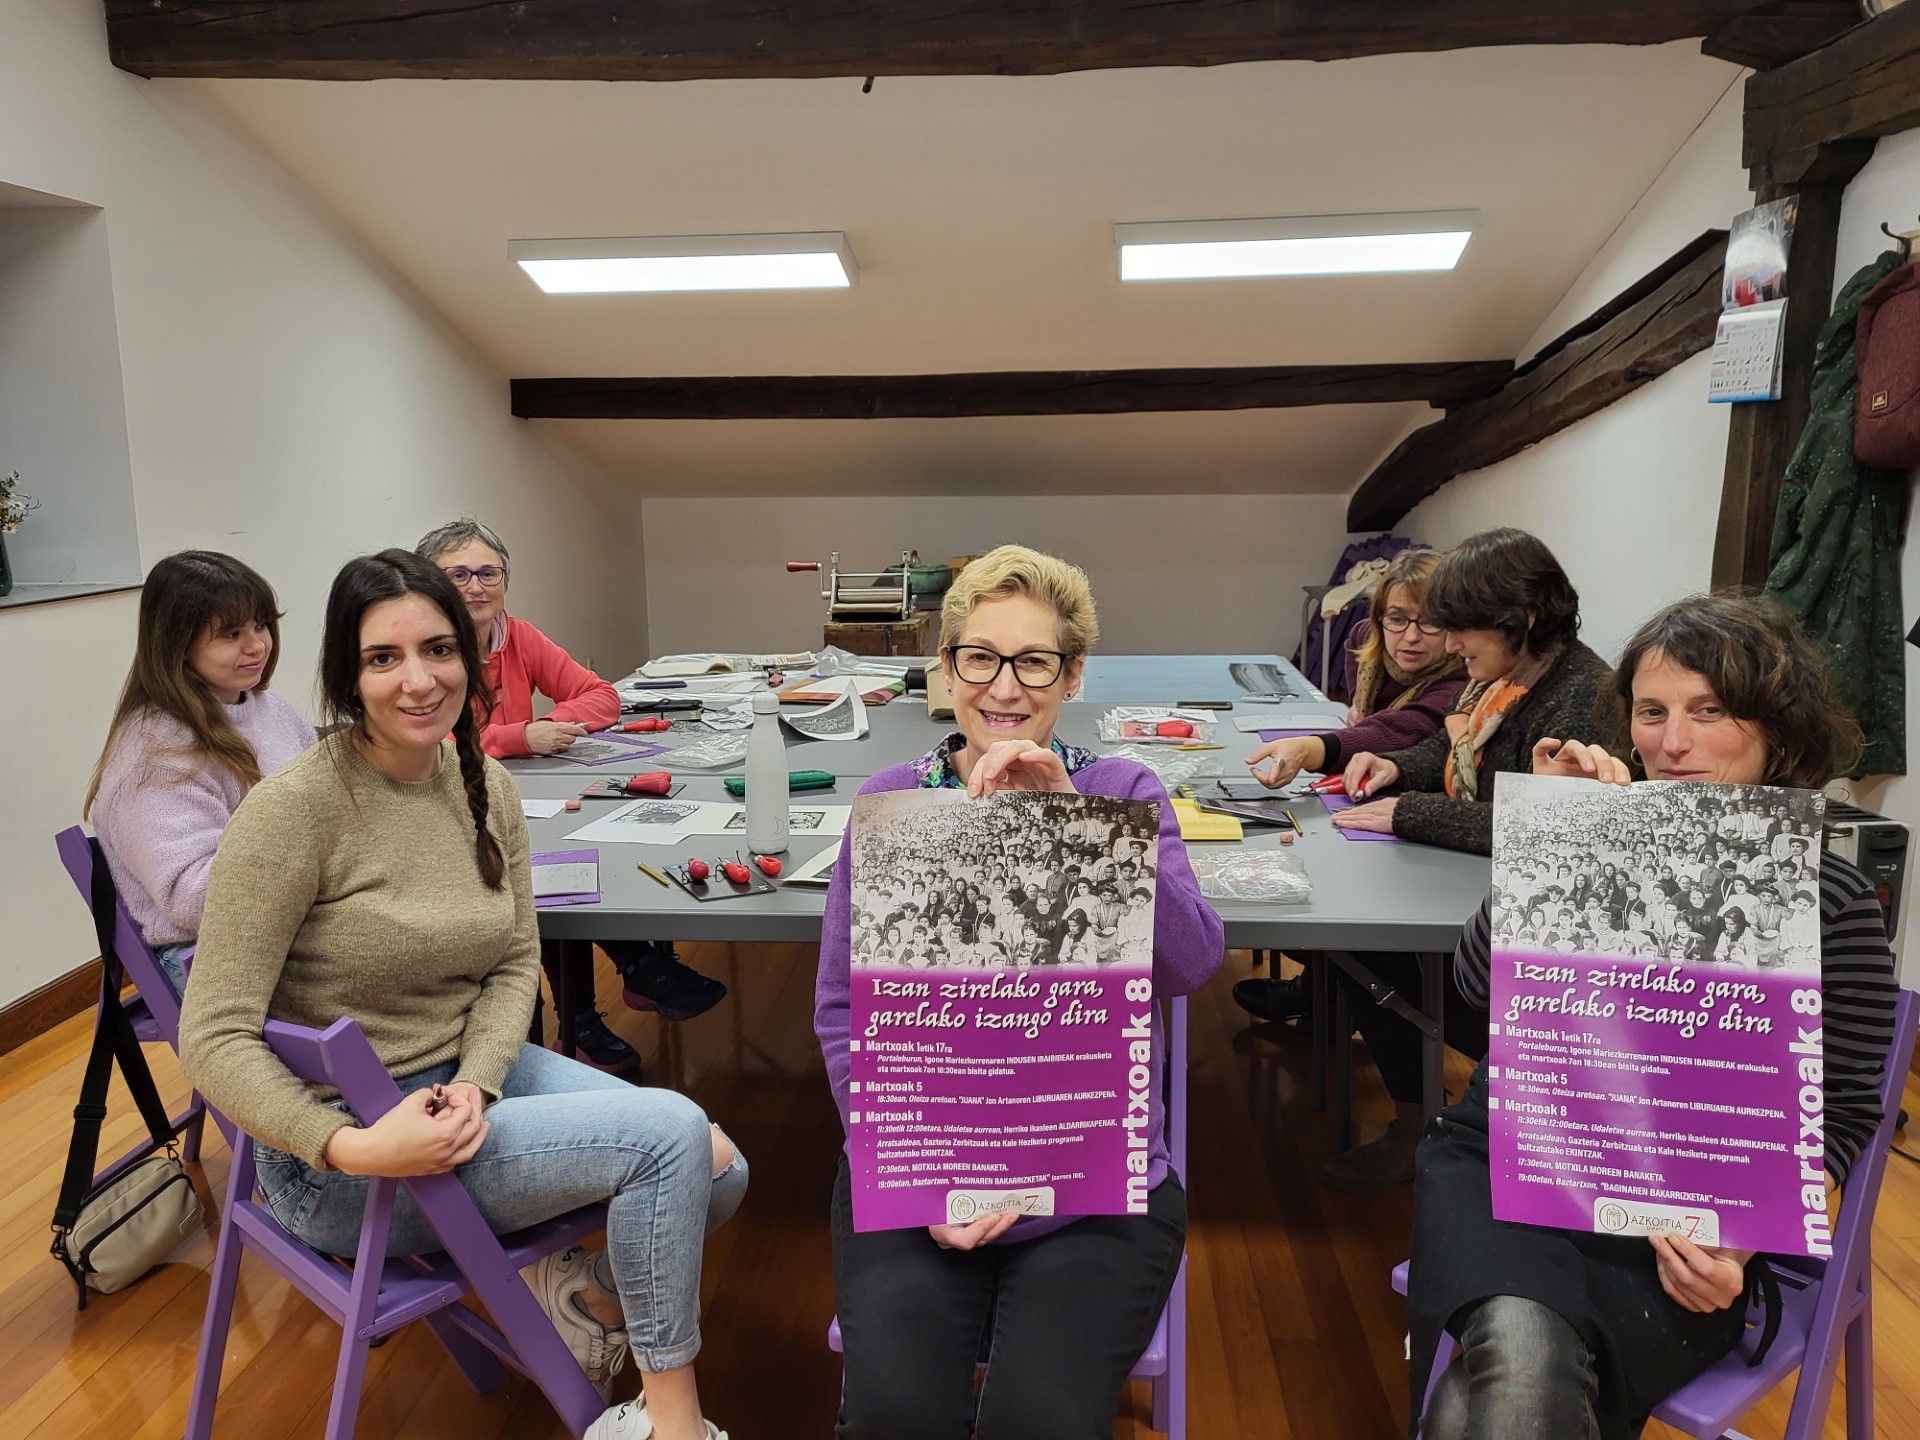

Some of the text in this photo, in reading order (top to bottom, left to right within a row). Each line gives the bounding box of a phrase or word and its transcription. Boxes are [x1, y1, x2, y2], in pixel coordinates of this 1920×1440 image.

[872, 972, 1104, 1009] Izan zirelako gara,
[1513, 961, 1766, 1009] Izan zirelako gara,
[864, 999, 1109, 1039] garelako izango dira
[1504, 988, 1773, 1038] garelako izango dira
[1506, 1024, 1559, 1041] Martxoak
[1582, 1032, 1602, 1045] 17ra
[866, 1040, 915, 1052] Martxoak
[935, 1042, 953, 1054] 17ra
[877, 1051, 1112, 1065] Portaleburun, Igone Mariezkurrenaren INDUSEN IBAIBIDEAK erakusketa
[1518, 1040, 1779, 1074] Portaleburun, Igone Mariezkurrenaren INDUSEN IBAIBIDEAK erakusketa
[1518, 1053, 1671, 1075] eta martxoak 7an 18:30ean bisita gidatua.
[890, 1065, 922, 1073] martxoak
[923, 1066, 936, 1074] 7an
[937, 1066, 967, 1075] 18:30ean
[967, 1066, 987, 1075] bisita
[988, 1067, 1016, 1077] gidatua.
[1505, 1067, 1568, 1085] Martxoak 5
[866, 1081, 923, 1092] Martxoak 5
[1121, 977, 1152, 1214] martxoak 8
[1505, 1099, 1568, 1117] Martxoak 8
[1518, 1084, 1787, 1119] 18:30ean, Oteiza aretoan. "JUANA" Jon Artanoren LIBURUAREN AURKEZPENA.
[866, 1110, 923, 1122] Martxoak 8
[1788, 988, 1833, 1256] martxoak 8
[877, 1138, 921, 1148] Arratsaldean,
[923, 1138, 952, 1146] Gazteria
[952, 1138, 989, 1147] Zerbitzuak
[1002, 1139, 1017, 1147] Kale
[1018, 1137, 1047, 1146] Heziketa
[1048, 1134, 1085, 1146] programak
[1517, 1115, 1789, 1152] 11:30etik 12:00etara, Udaletxe aurrean, Herriko ikasleen ALDARRIKAPENAK.
[877, 1148, 956, 1159] bultzatutako EKINTZAK.
[1517, 1131, 1750, 1164] Arratsaldean, Gazteria Zerbitzuak eta Kale Heziketa programak
[1517, 1142, 1605, 1160] bultzatutako EKINTZAK.
[877, 1162, 1009, 1174] 17:30etan, MOTXILA MOREEN BANAKETA.
[1517, 1157, 1666, 1182] 17:30etan, MOTXILA MOREEN BANAKETA.
[877, 1179, 912, 1189] 19:00etan,
[912, 1177, 950, 1187] Baztartxon,
[952, 1176, 994, 1185] "BAGINAREN
[994, 1173, 1050, 1185] BAKARRIZKETAK"
[1518, 1173, 1554, 1186] 19:00etan,
[1555, 1177, 1598, 1190] Baztartxon,
[1600, 1182, 1648, 1196] "BAGINAREN
[1649, 1188, 1713, 1203] BAKARRIZKETAK"
[978, 1200, 1022, 1211] AZKOITIA
[1630, 1215, 1682, 1230] AZKOITIA
